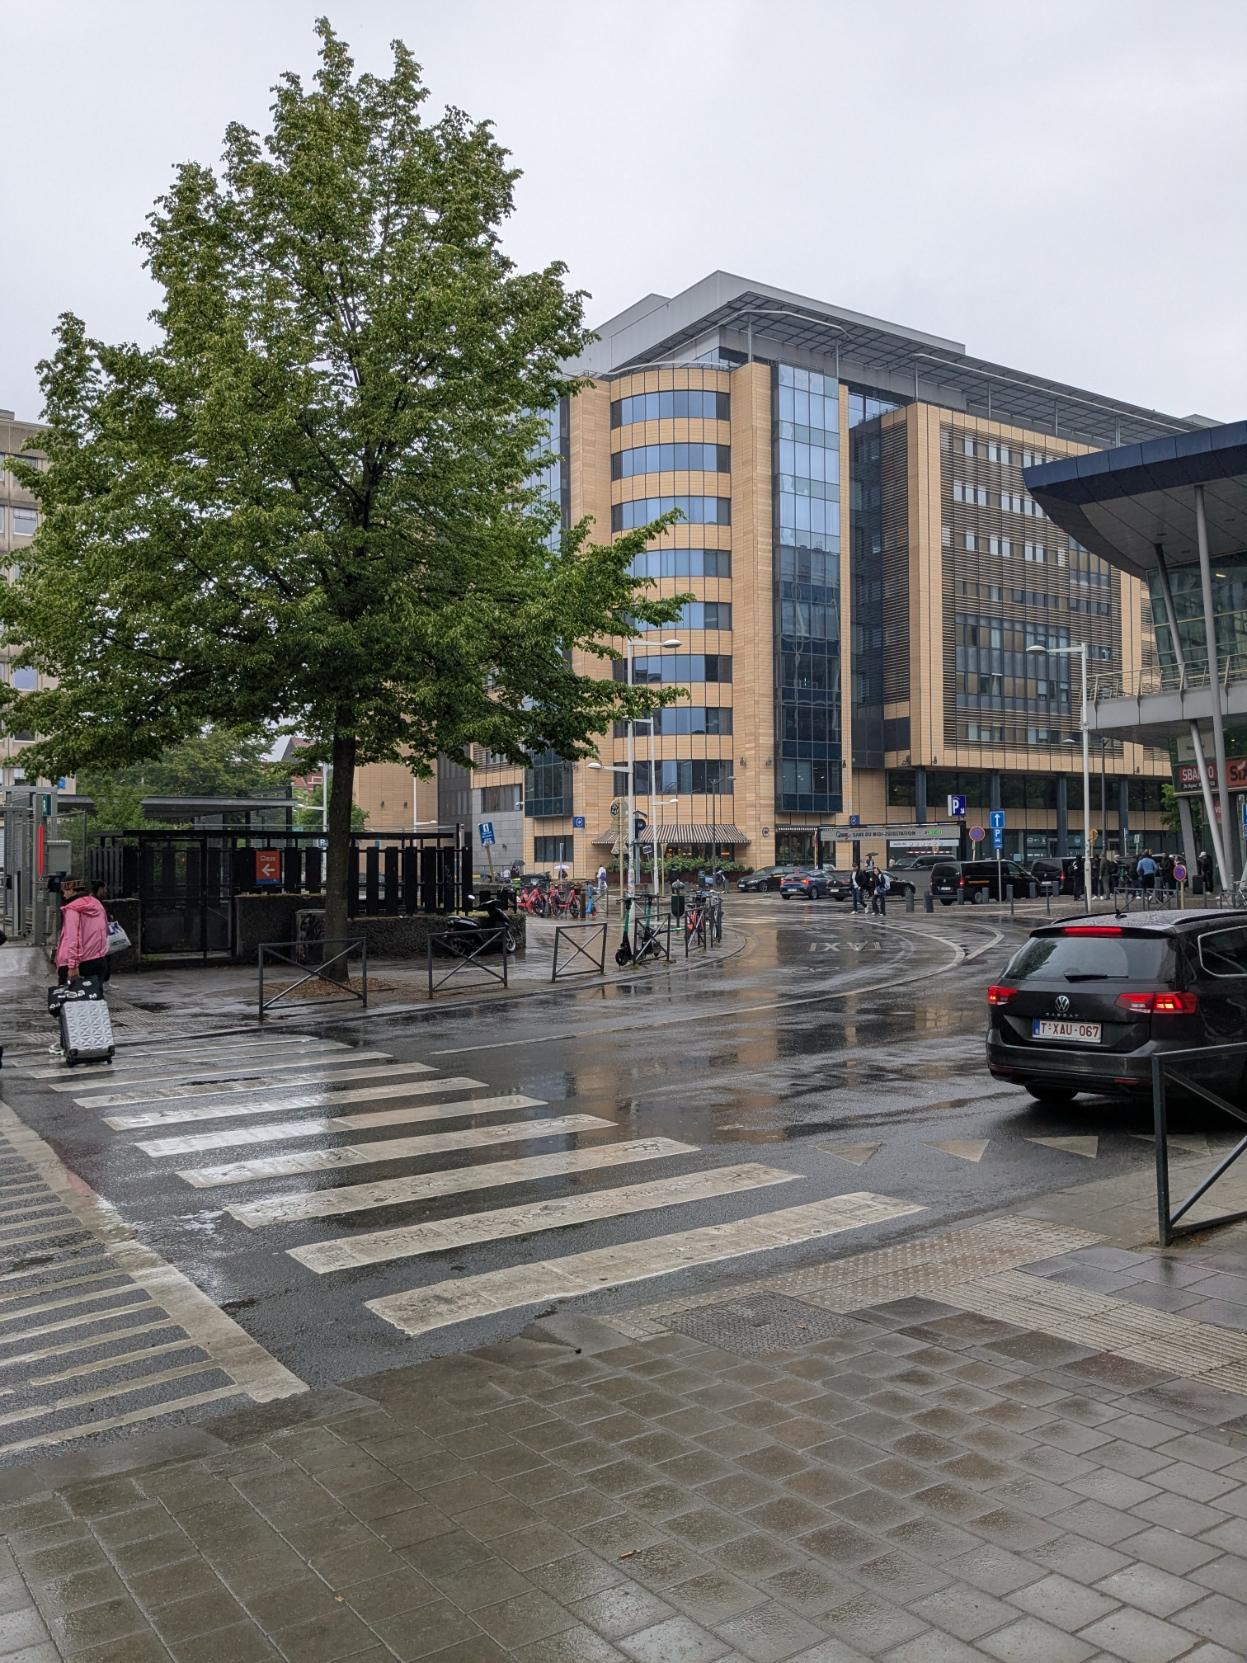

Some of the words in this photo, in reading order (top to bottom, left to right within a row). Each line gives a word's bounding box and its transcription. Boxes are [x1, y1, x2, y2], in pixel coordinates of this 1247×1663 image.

[1182, 766, 1214, 780] SBAO
[953, 799, 959, 814] P
[808, 941, 881, 951] TAXI
